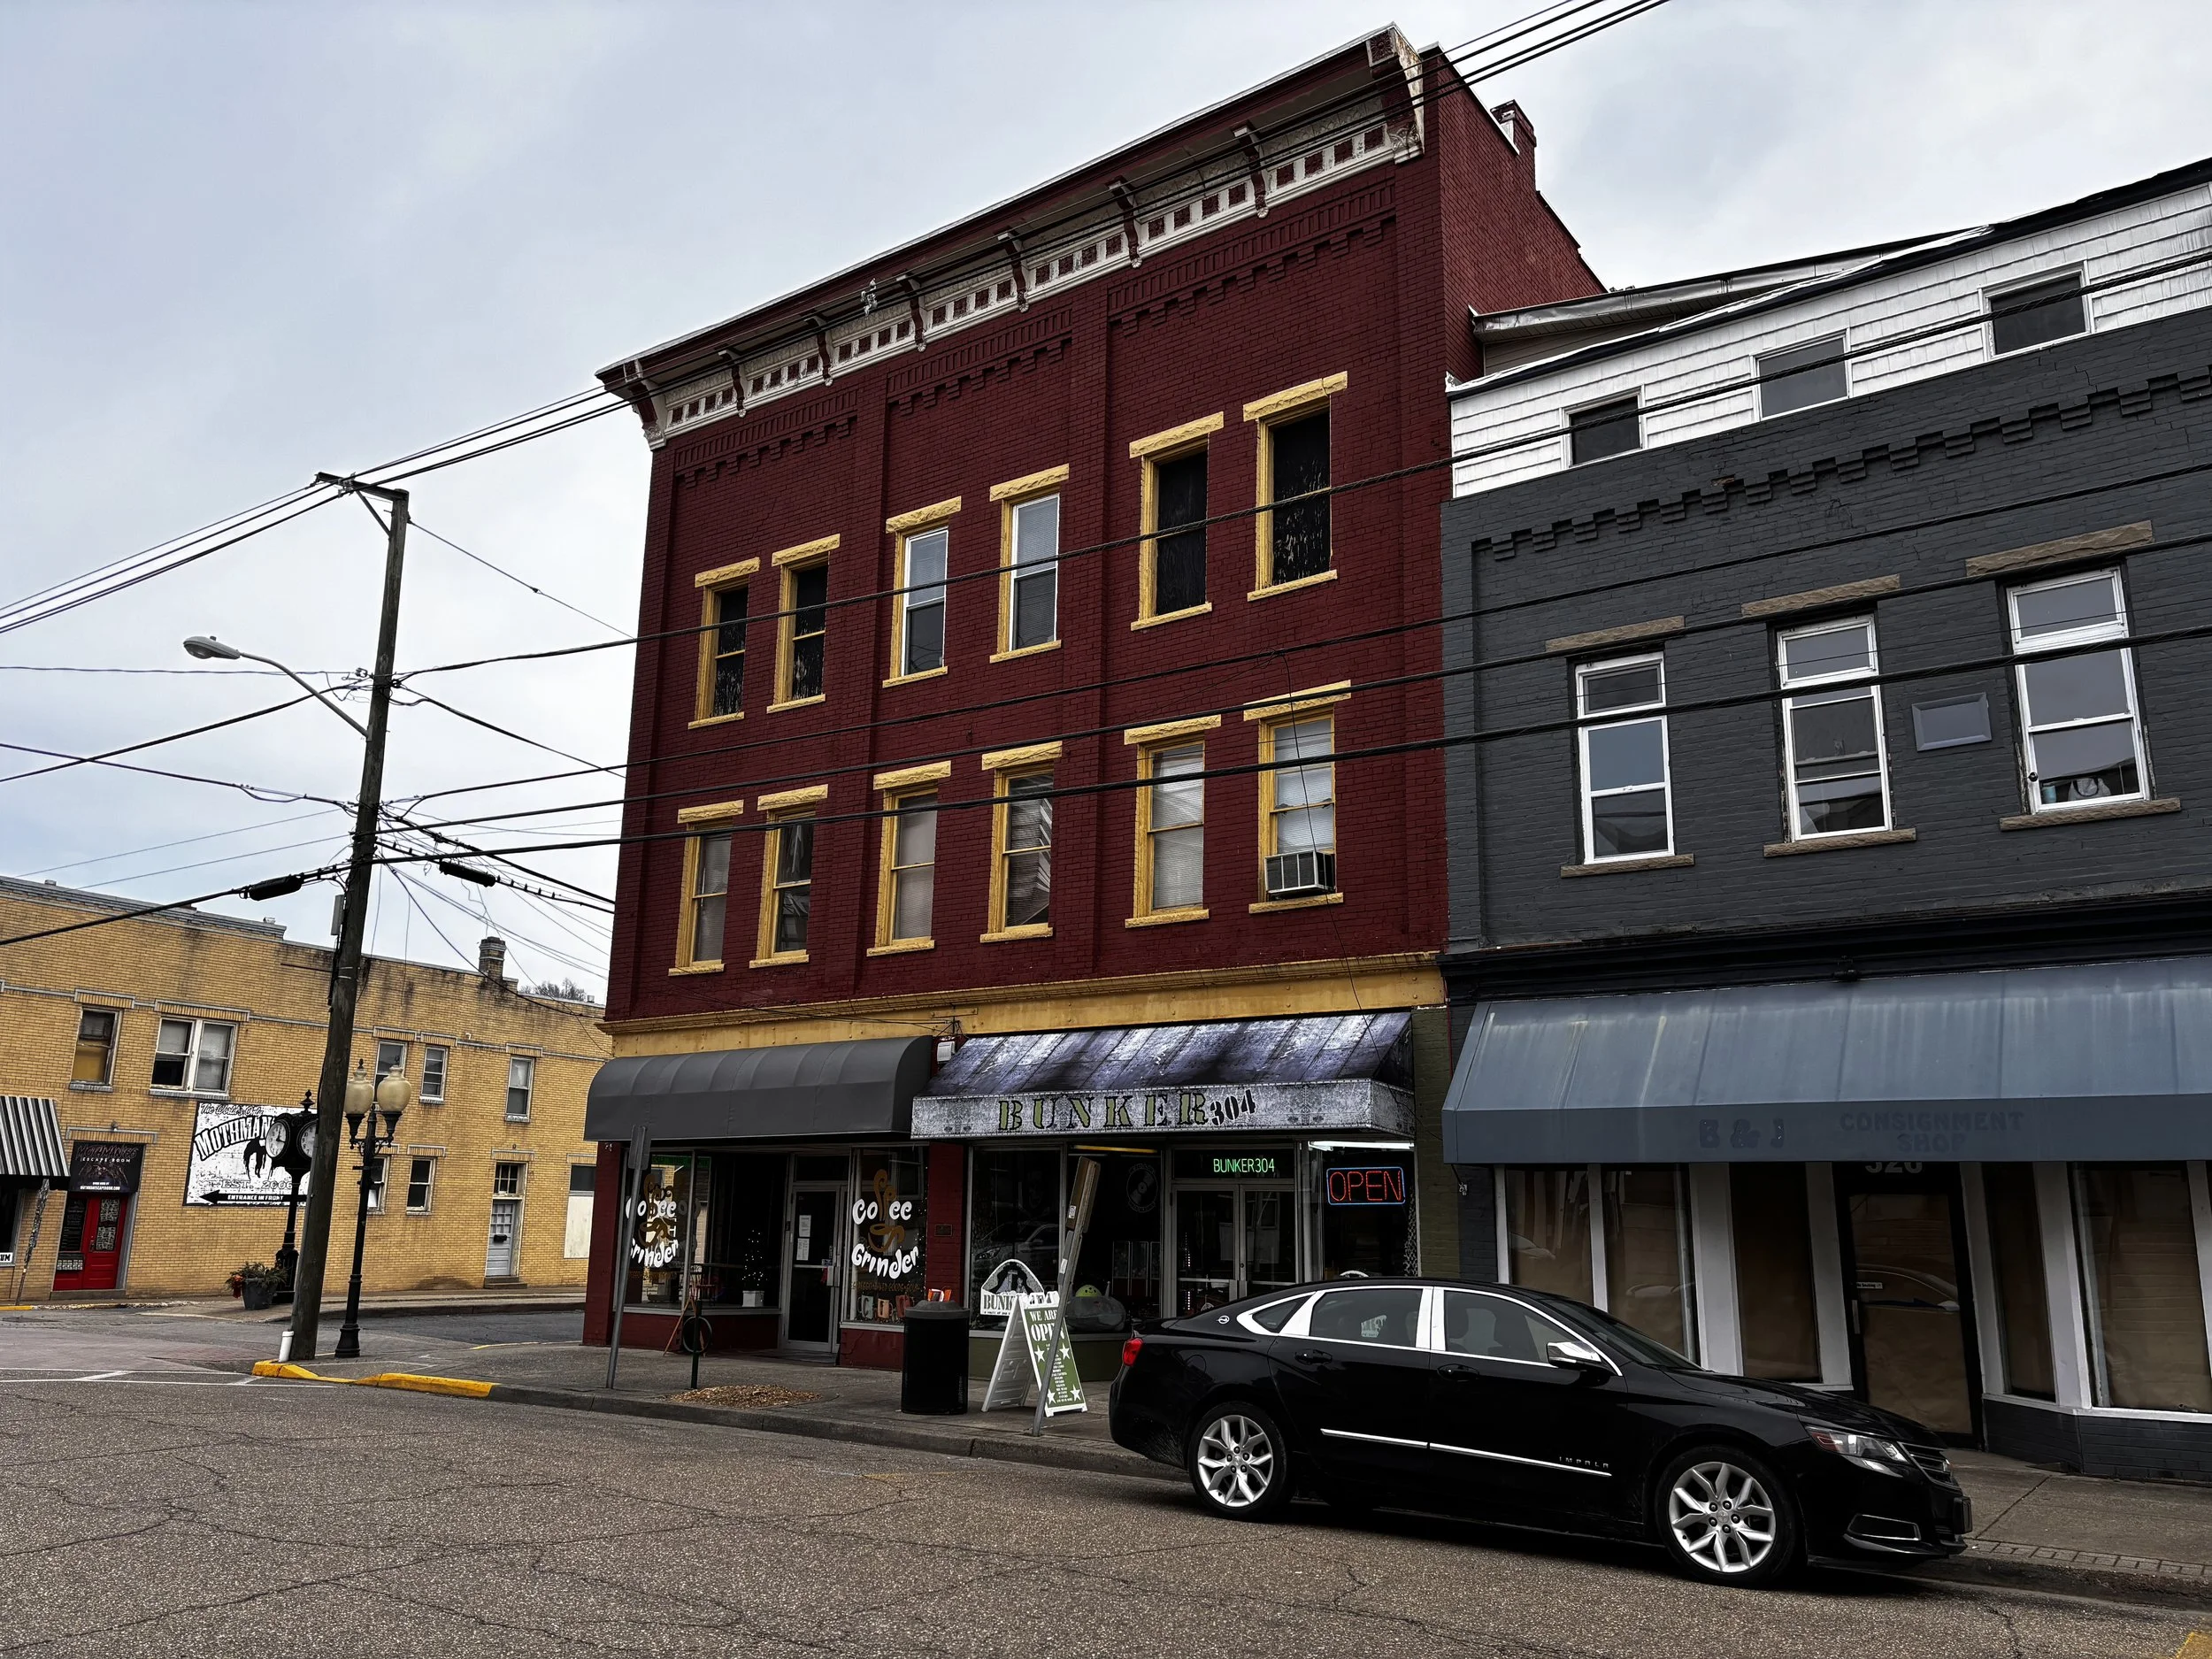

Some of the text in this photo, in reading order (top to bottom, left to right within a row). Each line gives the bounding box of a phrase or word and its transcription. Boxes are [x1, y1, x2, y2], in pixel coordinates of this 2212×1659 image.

[997, 1089, 1256, 1131] BUNKER 304
[1839, 1111, 2025, 1133] CONSIGNMENT
[1897, 1133, 1969, 1153] SHOP
[1213, 1158, 1275, 1173] BUNKER304
[221, 1179, 292, 1189] EST. 2006
[1329, 1170, 1402, 1202] OPEN
[851, 1243, 919, 1279] Grinder
[1029, 1310, 1042, 1322] WE
[1559, 1455, 1609, 1469] IMPALA
